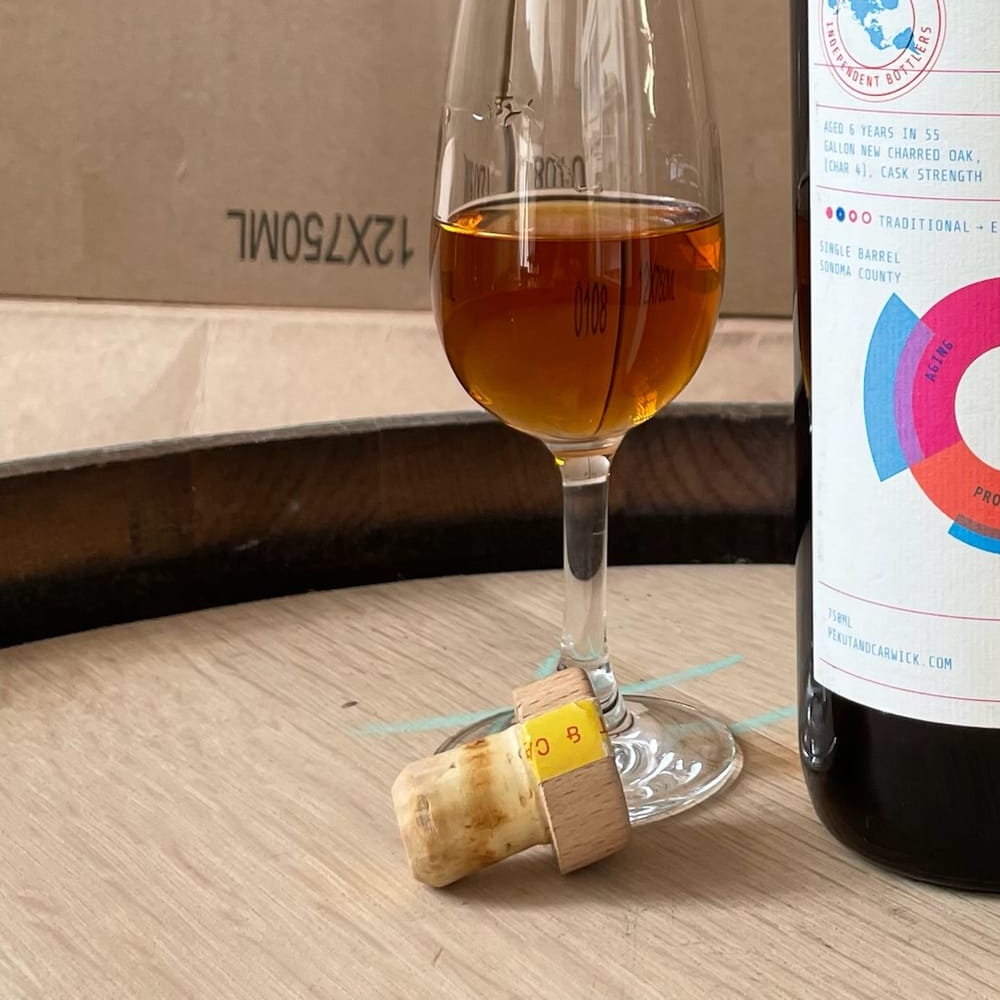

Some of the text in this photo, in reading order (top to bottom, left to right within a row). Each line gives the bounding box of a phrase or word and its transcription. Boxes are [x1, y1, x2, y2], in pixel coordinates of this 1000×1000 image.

[826, 21, 932, 87] INDEPENDENT BOTTLERS
[824, 120, 940, 141] AGED 6 YEARS IN 55
[824, 139, 980, 164] GALLON NEW CHARRED OAK,
[881, 166, 908, 180] CASK
[917, 169, 983, 182] STRENGTH
[880, 215, 970, 233] TRADITIONAL
[227, 209, 414, 267] 12X750ML
[819, 240, 900, 264] SINGLE BARREL
[819, 259, 901, 283] SONOMA COUNTY
[925, 339, 953, 382] AGING
[828, 608, 852, 629] 750ML
[828, 626, 953, 670] PEKUTANDCARWICK.COM
